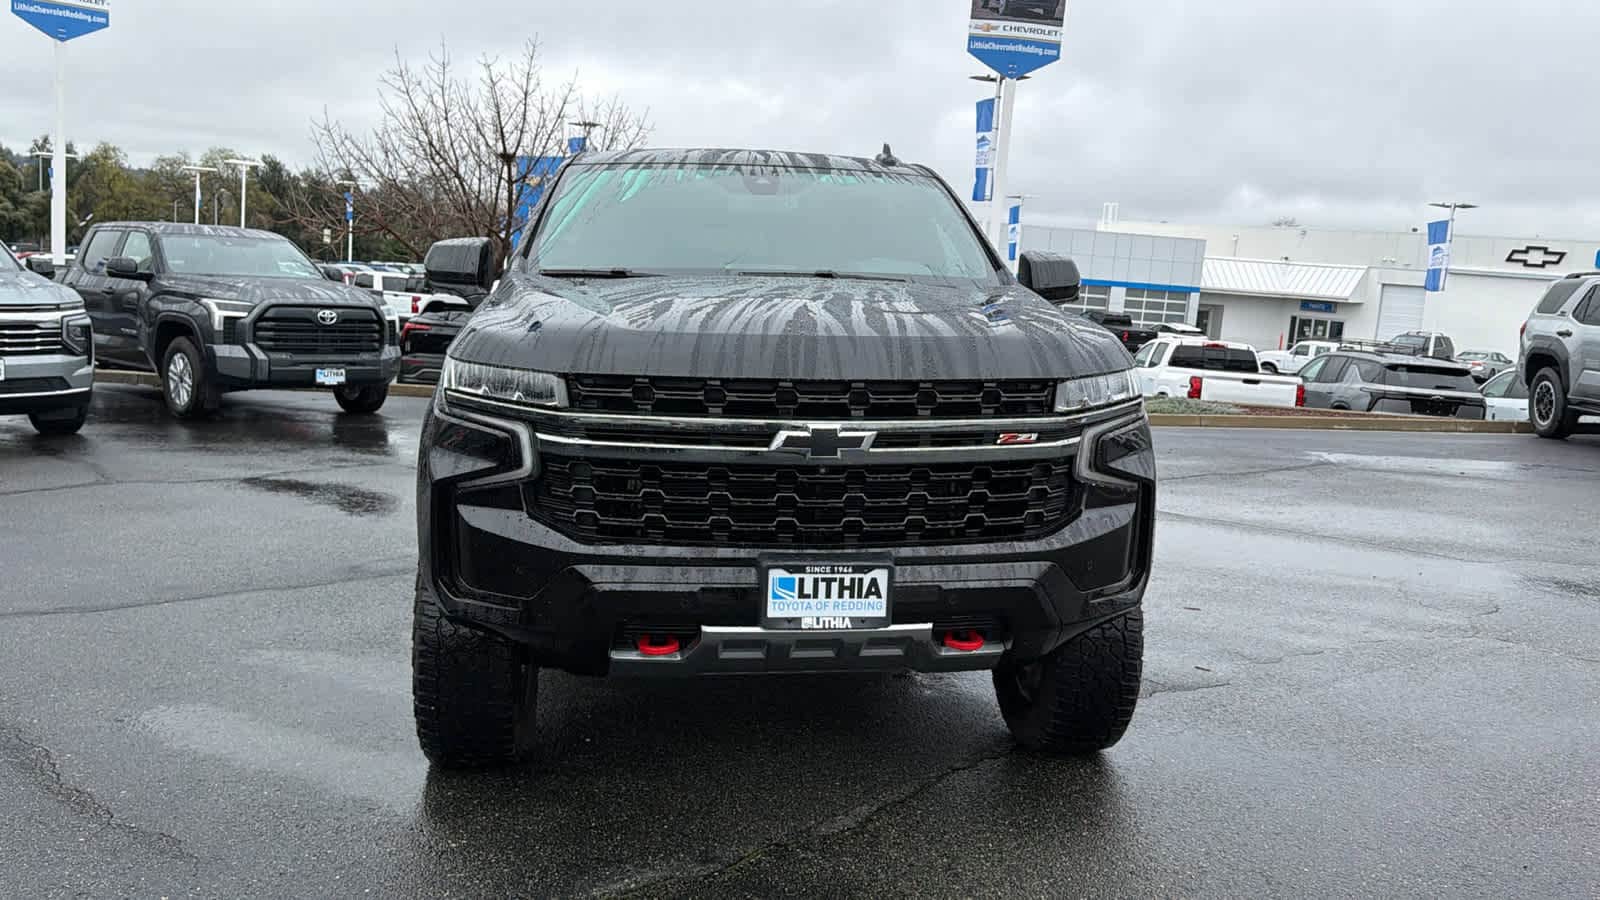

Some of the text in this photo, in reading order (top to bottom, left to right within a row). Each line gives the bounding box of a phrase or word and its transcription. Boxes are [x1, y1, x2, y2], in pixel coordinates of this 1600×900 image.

[1002, 24, 1059, 37] CHEVROLET
[797, 577, 882, 598] LITHIA
[772, 600, 883, 611] TOYOTA OF REDDING
[813, 617, 852, 628] LITHIA
